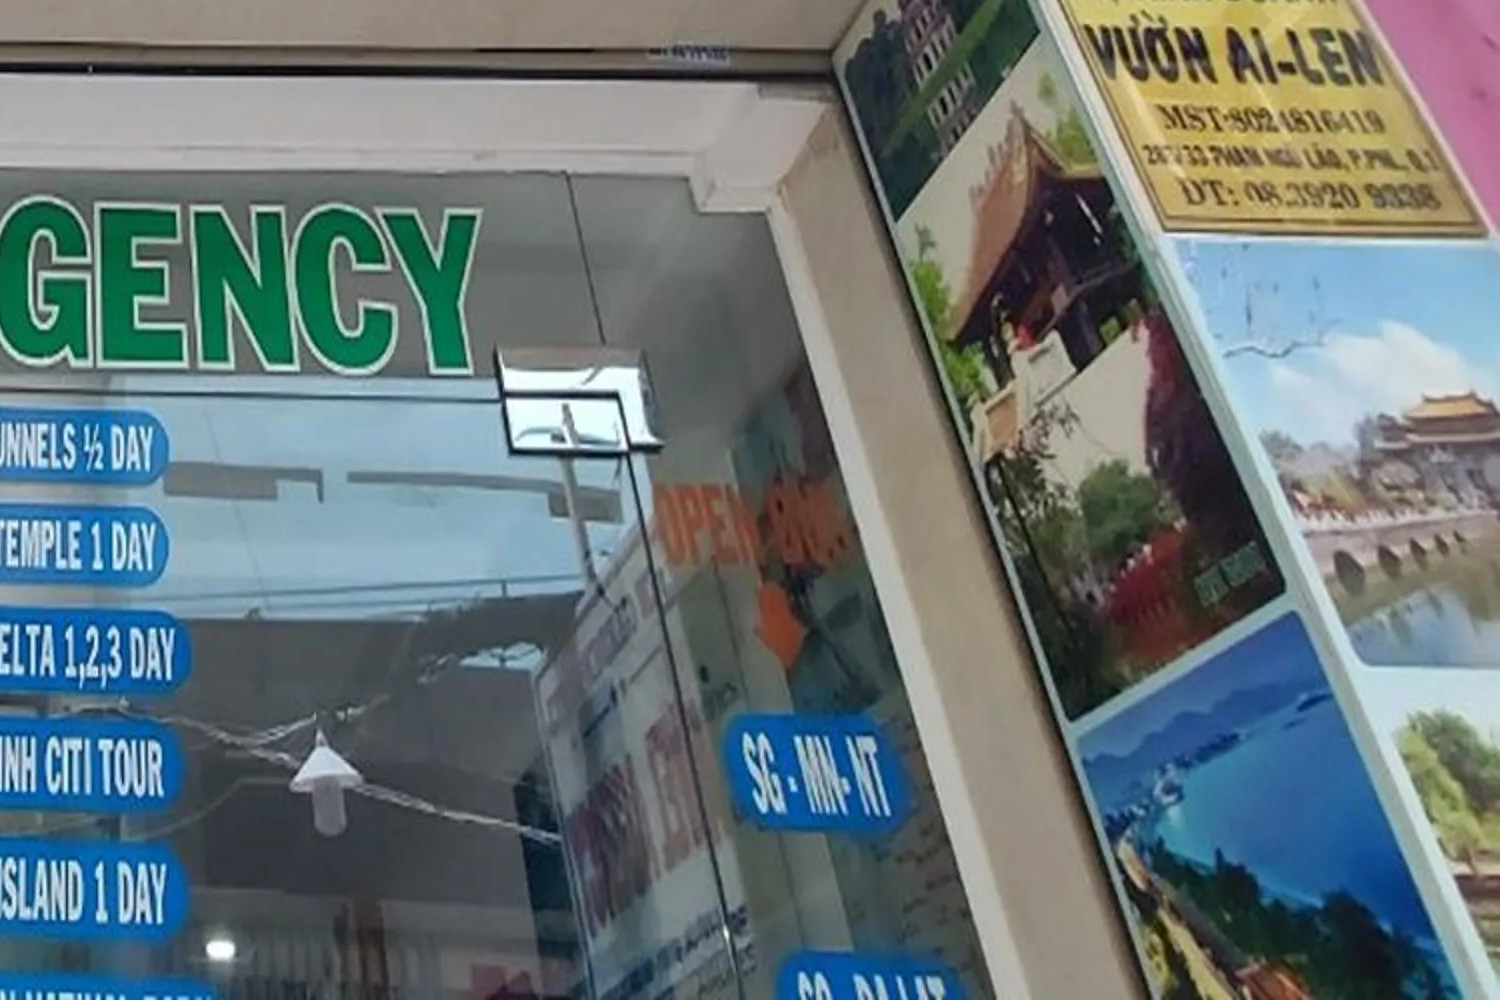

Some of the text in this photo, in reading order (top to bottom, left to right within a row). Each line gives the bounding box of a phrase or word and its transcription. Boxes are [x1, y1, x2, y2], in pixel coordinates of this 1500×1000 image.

[1083, 9, 1385, 87] VƯỜN AI-LEN
[110, 425, 153, 472] DAY
[90, 520, 104, 570] 1
[111, 523, 156, 571] DAY
[64, 625, 123, 689] 1,2,3
[129, 627, 176, 681] DAY
[44, 735, 91, 795] CITI
[97, 738, 164, 798] TOUR
[742, 731, 788, 815] SG
[94, 860, 109, 925] 1
[116, 861, 167, 925] DAY
